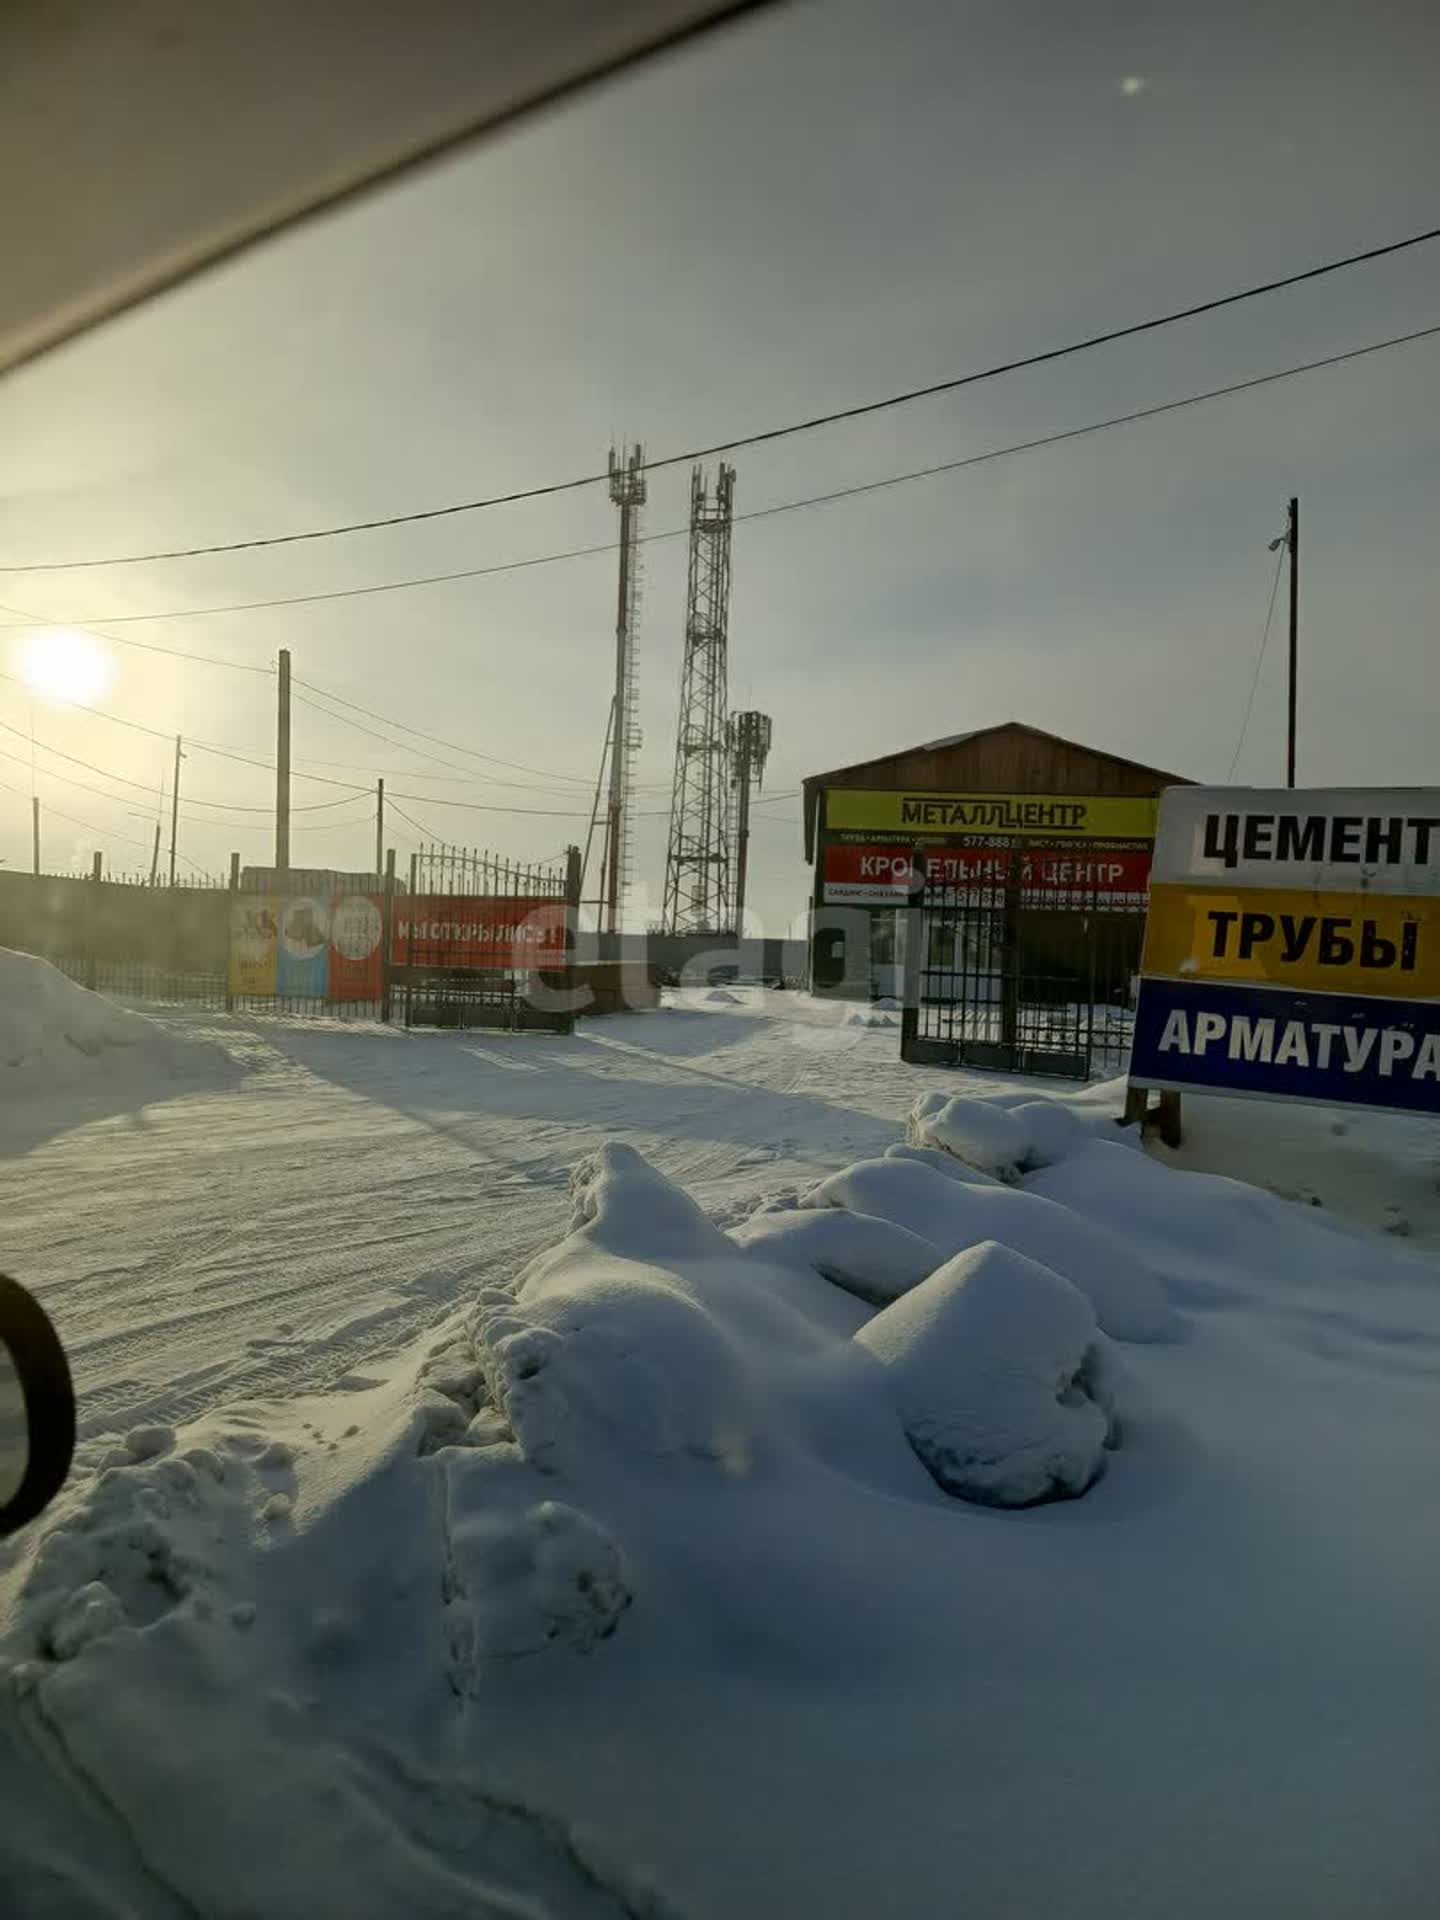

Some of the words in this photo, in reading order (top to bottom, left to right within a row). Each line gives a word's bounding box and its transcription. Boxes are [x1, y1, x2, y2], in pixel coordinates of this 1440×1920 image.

[901, 798, 1088, 829] МЕТАЛЛЦЕНТР
[1202, 814, 1440, 869] ЦЕМЕНТ
[1042, 858, 1124, 886] ЦЕНТР
[1208, 910, 1419, 972] ТРУБЫ
[1157, 1008, 1440, 1082] АРМАТУРА
